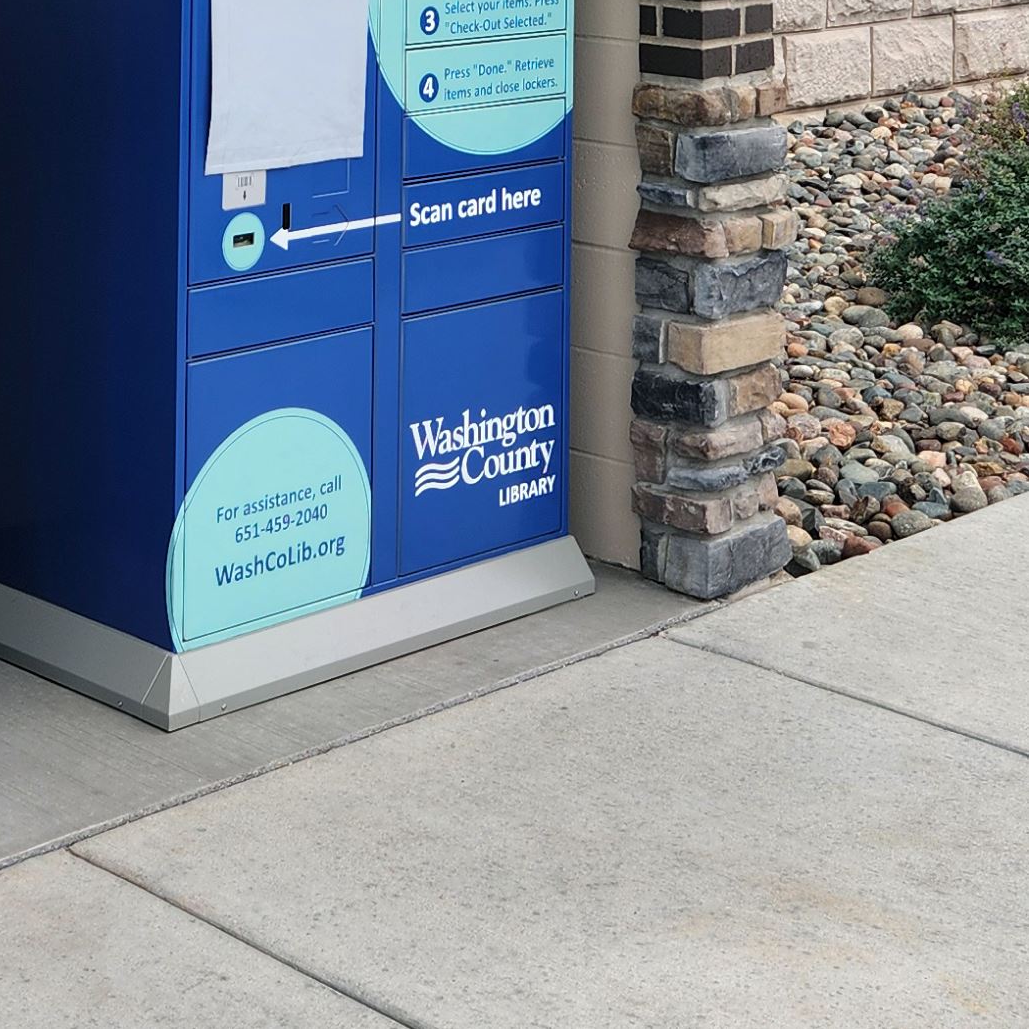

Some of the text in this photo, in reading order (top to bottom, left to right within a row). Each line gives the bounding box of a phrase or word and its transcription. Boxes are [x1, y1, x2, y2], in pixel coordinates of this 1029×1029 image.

[424, 11, 435, 32] 3
[445, 2, 475, 15] Select
[477, 0, 500, 15] your
[445, 18, 501, 35] "Check-Out
[423, 77, 434, 98] 4
[444, 67, 471, 80] Press
[515, 57, 554, 72] Retrieve
[444, 77, 558, 101] items and close lockers.
[410, 187, 541, 227] Scan card here
[410, 403, 555, 460] Washington
[460, 439, 555, 485] County
[217, 475, 342, 523] For assistance, call
[499, 474, 555, 507] LIBRARY
[235, 504, 328, 544] 651-459-2040
[215, 534, 345, 587] WashCoLib.org
